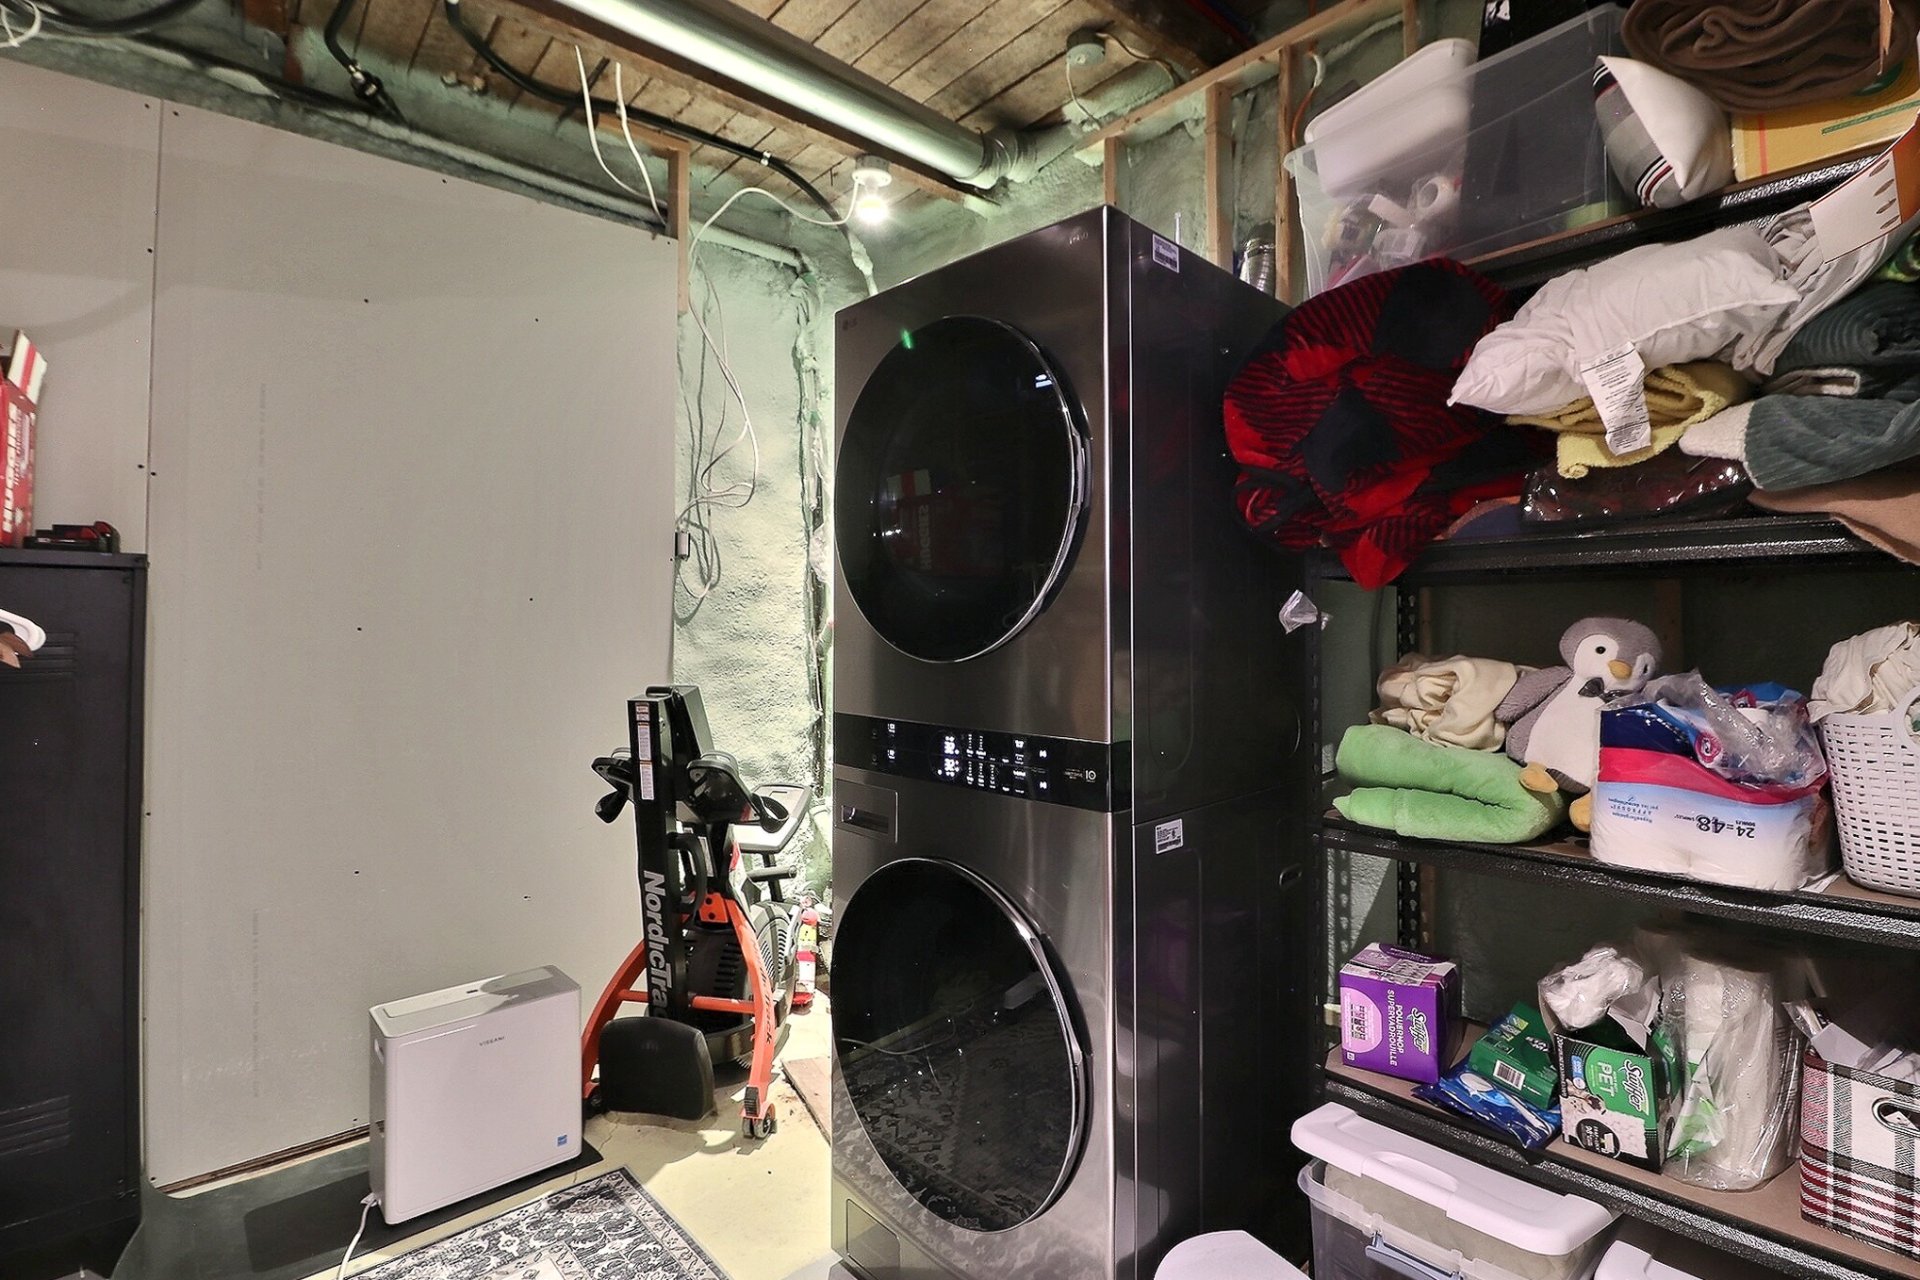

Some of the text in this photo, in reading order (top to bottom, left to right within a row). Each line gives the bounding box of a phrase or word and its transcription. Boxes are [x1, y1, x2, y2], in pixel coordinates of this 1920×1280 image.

[3, 401, 17, 534] HUGGIES
[1696, 814, 1726, 834] 48
[1736, 826, 1755, 839] 24
[643, 869, 673, 1018] NordicTrac
[1387, 989, 1397, 1066] SUPERVADROUILLE
[1409, 1007, 1429, 1054] Swiffer
[1598, 1062, 1614, 1096] PET
[1622, 1059, 1647, 1114] Swiffer
